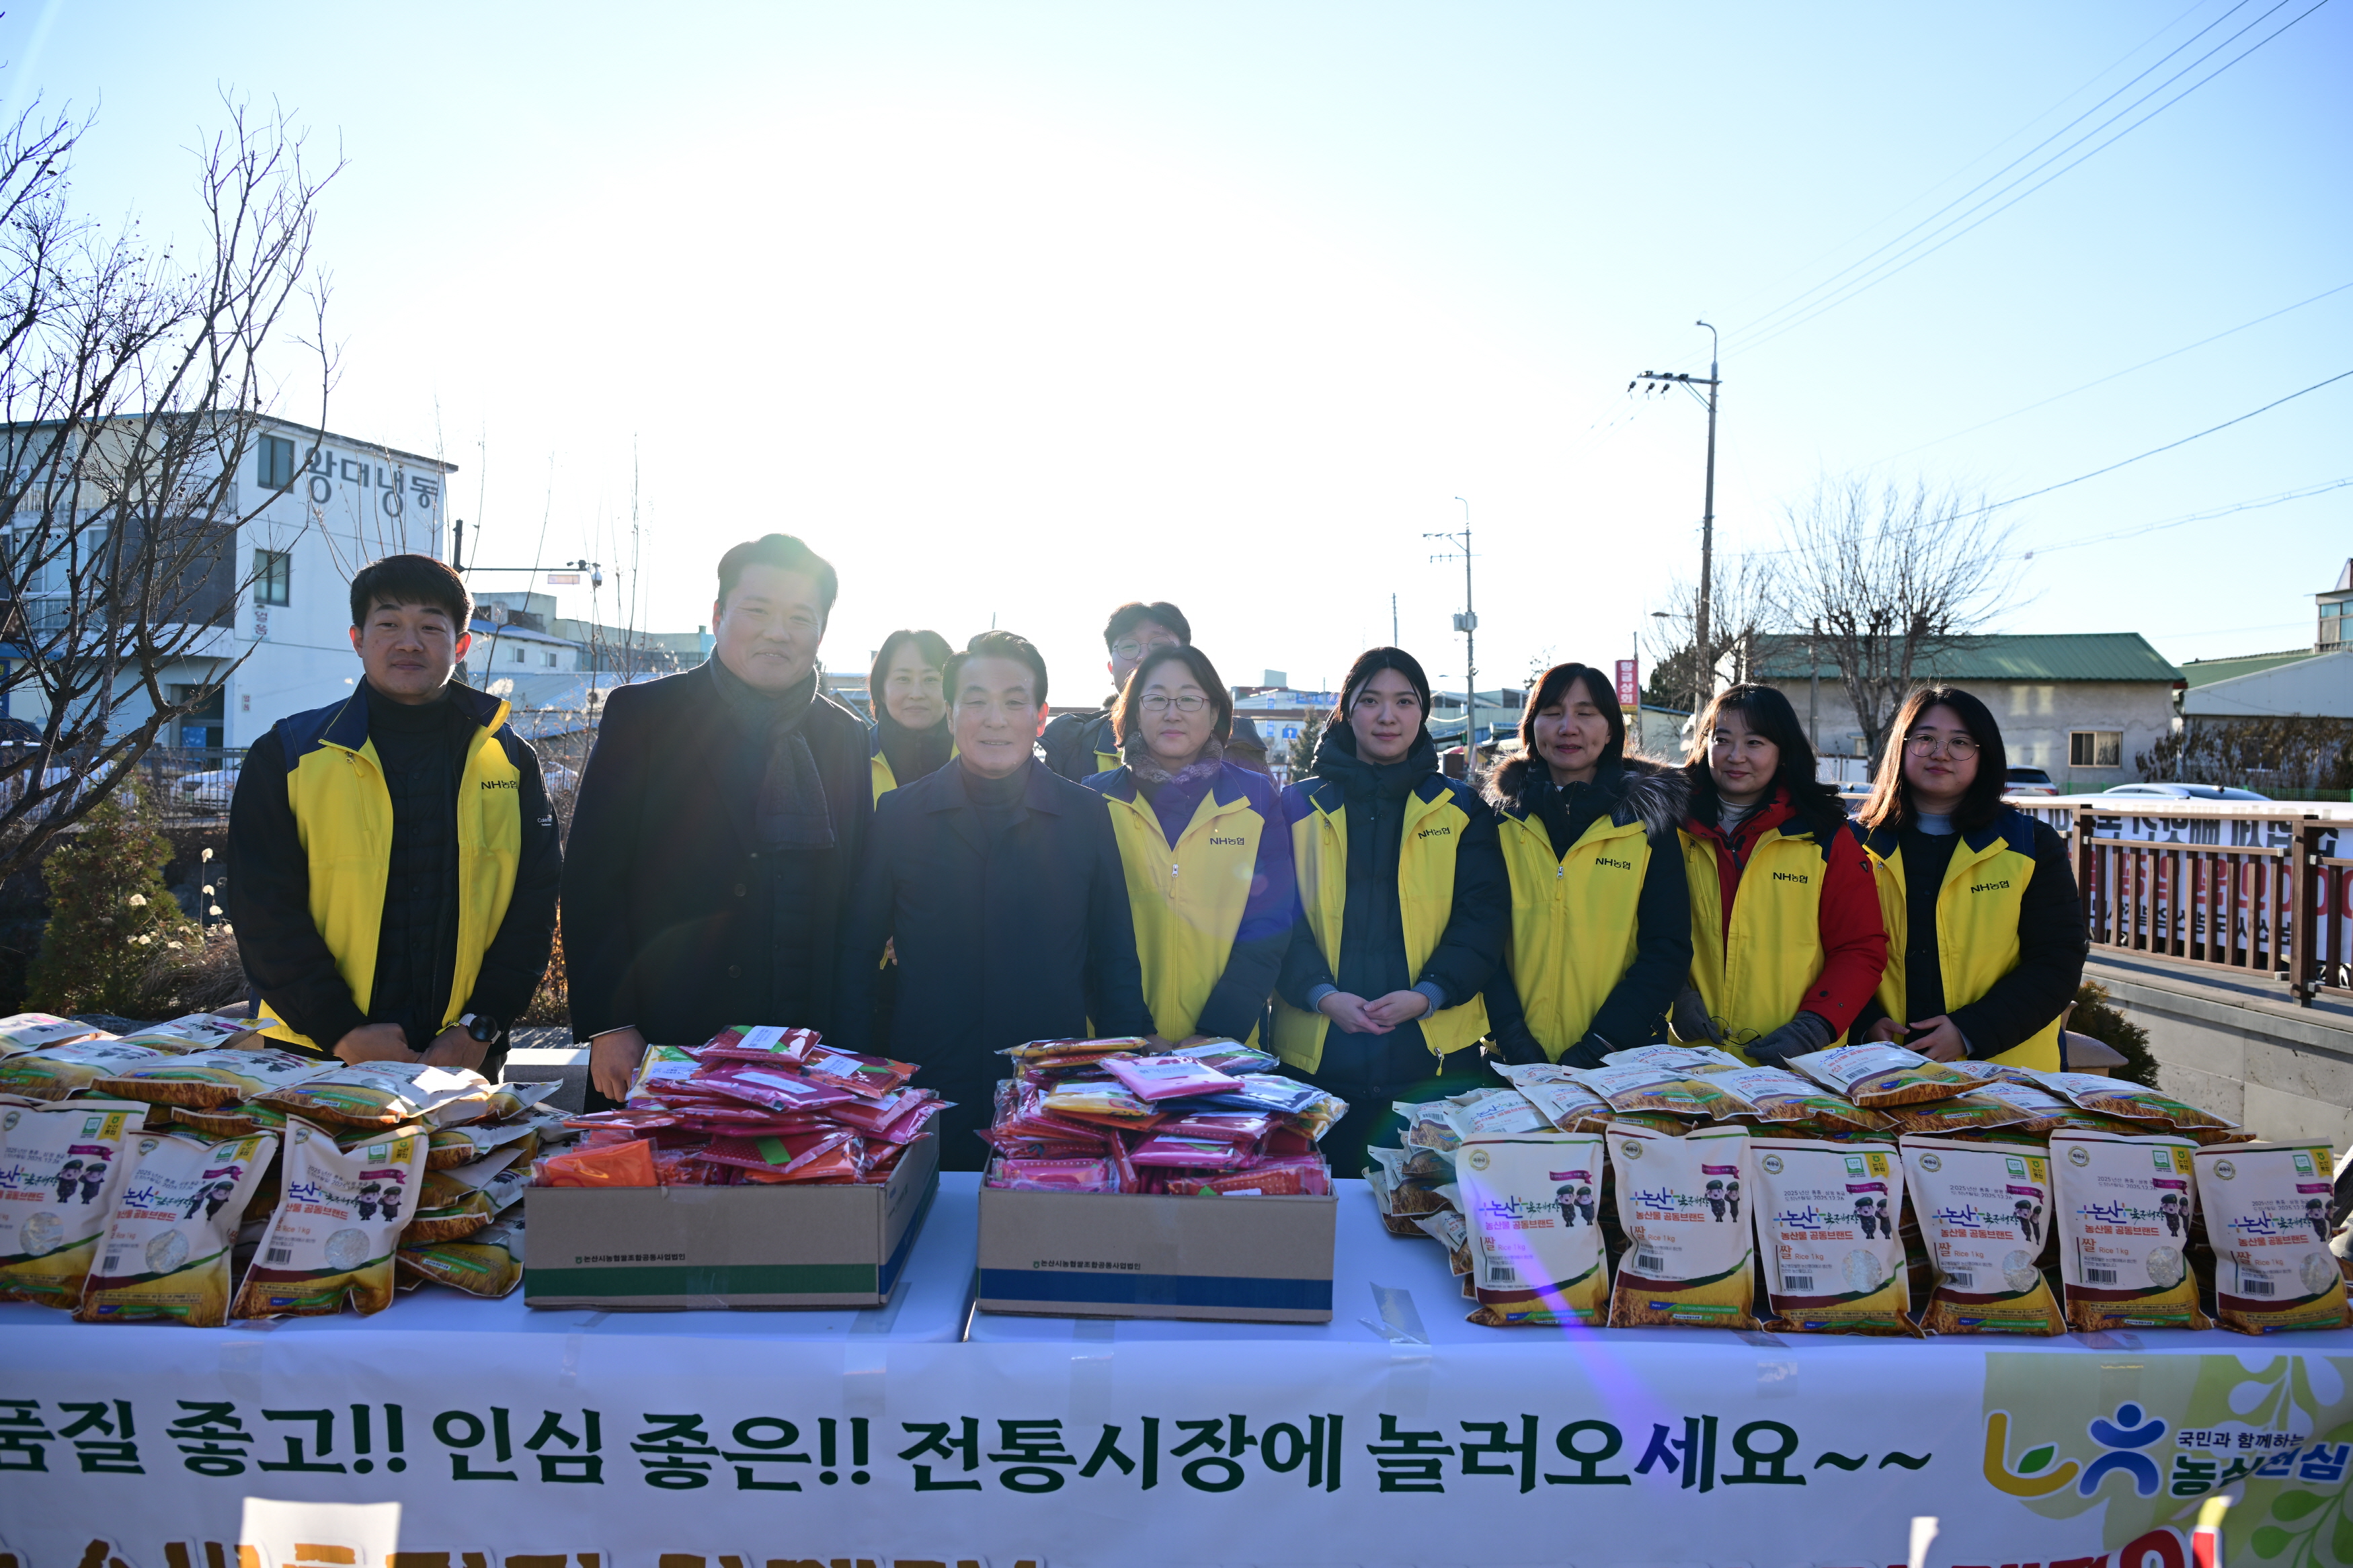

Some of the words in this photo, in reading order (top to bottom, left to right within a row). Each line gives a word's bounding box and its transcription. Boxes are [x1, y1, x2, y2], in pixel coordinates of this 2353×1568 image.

[305, 447, 437, 518] 왕대냉동
[481, 780, 517, 790] NH농협
[1418, 827, 1450, 840] NH농협
[1210, 836, 1244, 846] NH농협
[1595, 858, 1631, 870] NH농협
[1773, 872, 1808, 884] NH농협
[1970, 880, 2009, 894] NH농협
[123, 1186, 154, 1208] 논산
[288, 1181, 321, 1203] 논산
[1637, 1187, 1674, 1210] 논산
[286, 1203, 302, 1213] 산물
[305, 1204, 349, 1220] 공동브랜드
[1486, 1195, 1523, 1219] 논산
[2086, 1200, 2127, 1223] 논산
[133, 1209, 177, 1221] 공동브랜드
[1636, 1211, 1661, 1221] 농산물
[1664, 1212, 1705, 1222] 공동브랜드
[1782, 1205, 1821, 1229] 논산
[1941, 1204, 1981, 1227] 논산
[1486, 1221, 1510, 1231] 농산물
[1513, 1219, 1554, 1230] 공동브랜드
[2238, 1210, 2276, 1235] 논산
[1634, 1226, 1646, 1240] 쌀
[1782, 1231, 1807, 1240] 농산물
[1810, 1231, 1853, 1240] 공동브랜드
[1941, 1229, 1967, 1238] 농산물
[1970, 1229, 2013, 1240] 공동브랜드
[2085, 1225, 2113, 1234] 농산물
[2116, 1225, 2159, 1236] 공동브랜드
[1484, 1237, 1495, 1251] 쌀
[2081, 1238, 2096, 1253] 쌀
[2238, 1237, 2266, 1247] 농산물
[2268, 1235, 2309, 1245] 공동브랜드
[1780, 1245, 1792, 1260] 쌀
[1939, 1242, 1952, 1257] 쌀
[2237, 1251, 2251, 1265] 쌀
[0, 1399, 146, 1475] 품질
[165, 1399, 408, 1477] 좋고!!
[432, 1405, 604, 1485] 인심
[630, 1413, 871, 1492] 좋은!!
[898, 1413, 1343, 1493] 전통시장에
[1367, 1413, 1932, 1493] 놀러오세요~~
[2178, 1431, 2231, 1448] 국민과
[2238, 1432, 2305, 1448] 함께하는
